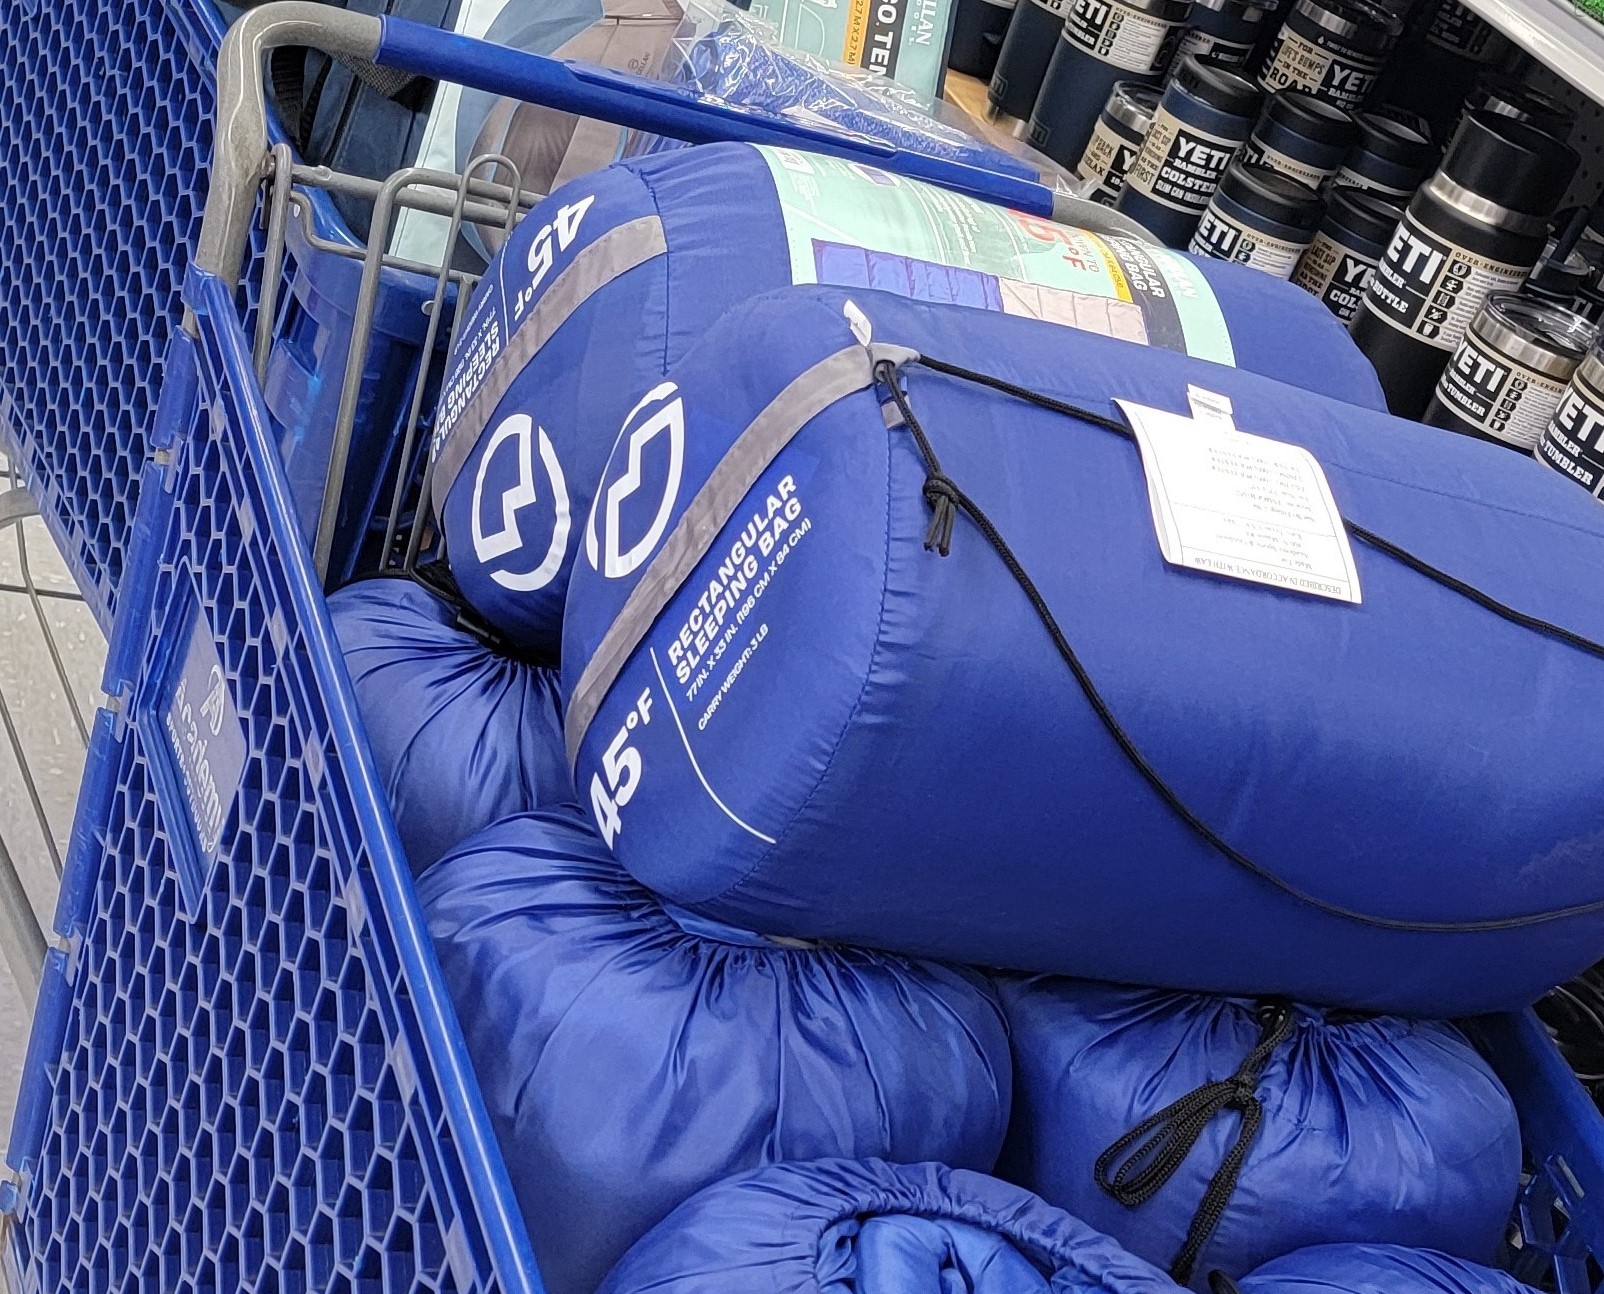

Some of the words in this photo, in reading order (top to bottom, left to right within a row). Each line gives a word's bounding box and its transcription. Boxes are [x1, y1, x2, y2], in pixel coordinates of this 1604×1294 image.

[875, 0, 899, 27] O.
[915, 0, 938, 46] LLAN
[1074, 0, 1109, 26] ETI
[868, 31, 894, 76] TEN
[1298, 42, 1314, 54] FOR
[1298, 54, 1326, 75] BUMPS
[1292, 67, 1309, 80] THE
[1173, 157, 1218, 179] RAMBLER
[1177, 136, 1231, 171] YETI
[1161, 166, 1217, 193] COLSTER
[1198, 209, 1237, 251] ETI
[1323, 253, 1337, 266] SIP
[1387, 220, 1445, 285] ETI
[1125, 262, 1148, 291] BAG
[1373, 280, 1409, 313] BOTTLE
[447, 320, 499, 409] SLEEPING
[1447, 383, 1486, 417] TUMBLER
[1544, 440, 1595, 486] TUMBLER
[668, 475, 797, 666] RECTANGULAR
[1194, 557, 1212, 567] LAW
[1213, 559, 1234, 572] WITH
[1235, 565, 1288, 583] ACCORDANCE
[676, 555, 758, 684] SLEEPING
[758, 497, 801, 557] BAG
[1300, 579, 1342, 595] DESCRIBED
[686, 681, 698, 702] 77
[696, 668, 710, 688] IN.
[706, 655, 716, 670] X
[714, 638, 727, 660] 33
[724, 623, 739, 643] IN.
[753, 571, 771, 597] CM
[767, 560, 778, 577] X
[776, 543, 790, 565] 84
[788, 517, 812, 547] CM)
[698, 689, 722, 731] CARRY
[721, 647, 753, 693] WEIGHT:
[756, 623, 769, 642] LB
[590, 688, 654, 850] 45°F
